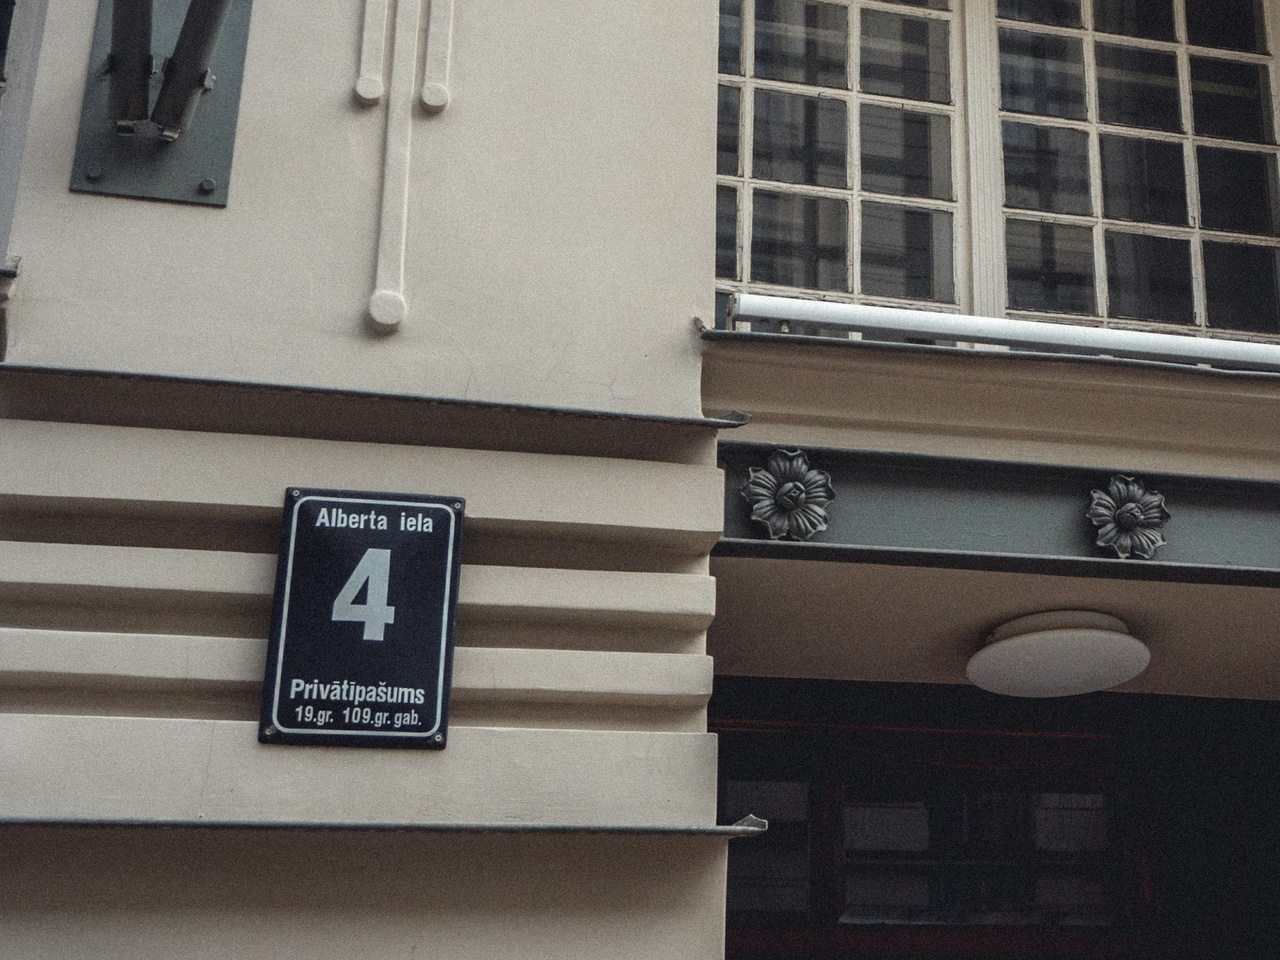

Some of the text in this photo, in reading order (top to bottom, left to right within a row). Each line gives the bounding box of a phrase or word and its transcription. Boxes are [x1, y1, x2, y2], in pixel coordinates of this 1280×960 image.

[315, 507, 433, 532] Alberta iela
[331, 548, 395, 641] 4
[290, 678, 425, 705] Privātīpašums
[295, 705, 422, 728] 19.gr. 109.gr. gab.
